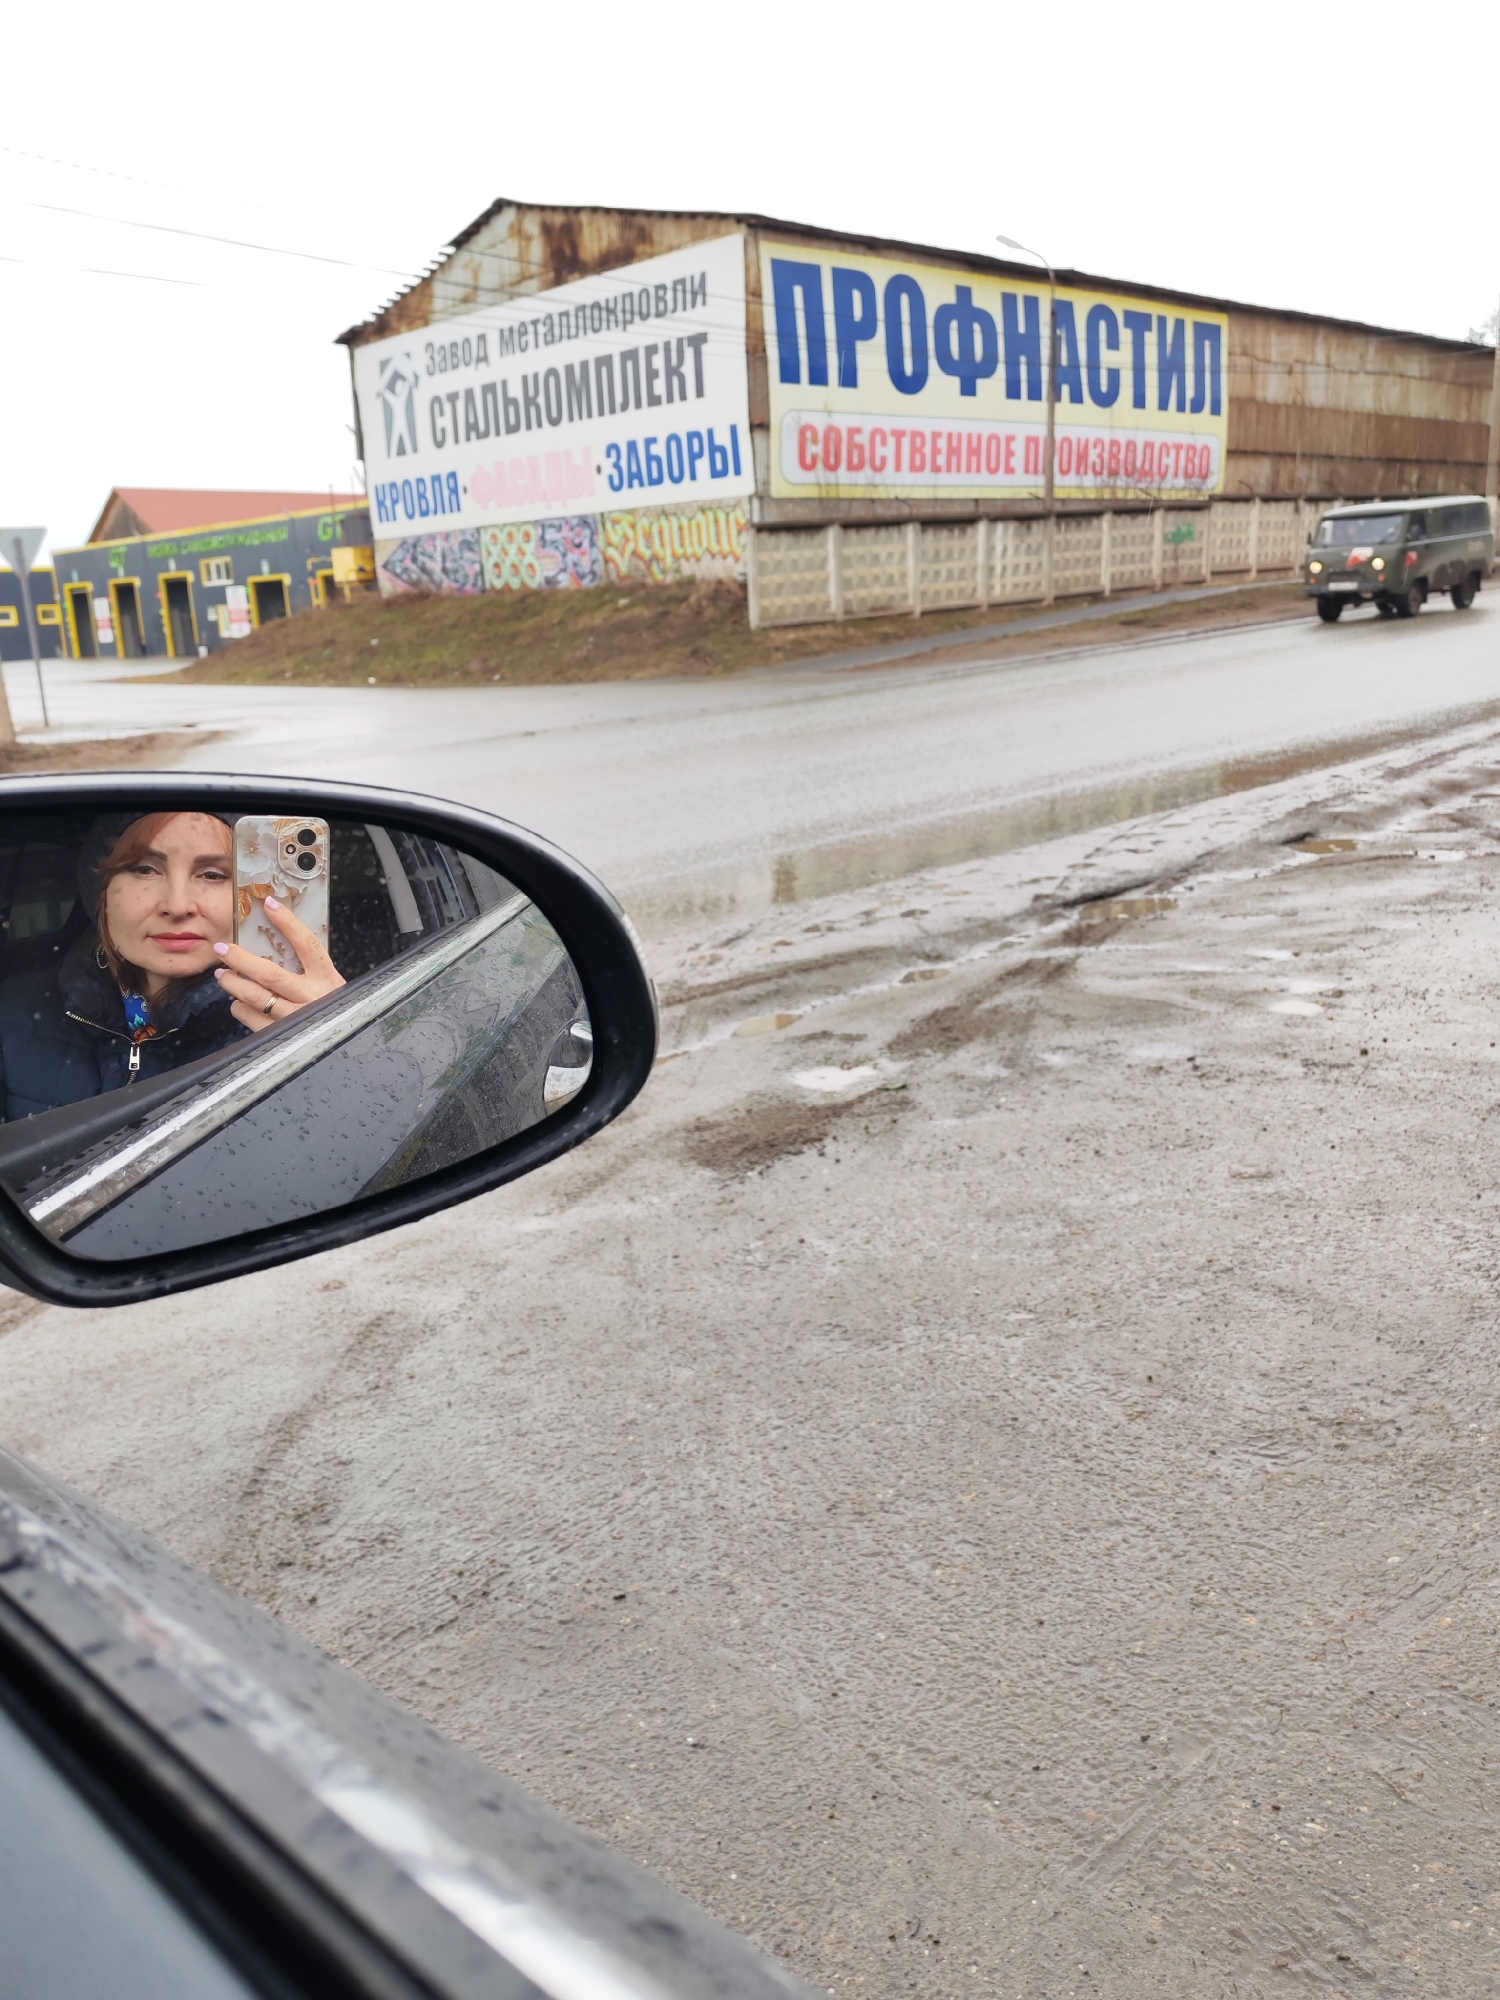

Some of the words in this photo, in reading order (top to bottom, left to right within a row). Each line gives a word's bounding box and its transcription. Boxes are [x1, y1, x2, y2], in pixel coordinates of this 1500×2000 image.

[425, 334, 489, 377] Завод
[499, 271, 708, 357] металлокровли
[771, 258, 1221, 416] ПРОФНАСТИЛ
[429, 332, 708, 449] СТАЛЬКОМПЛЕКТ
[375, 471, 461, 522] КРОВЛЯ
[471, 448, 595, 509] ФАСАДЫ
[606, 424, 742, 492] ЗАБОРЫ
[798, 423, 1016, 475] СОБСТВЕННОЕ
